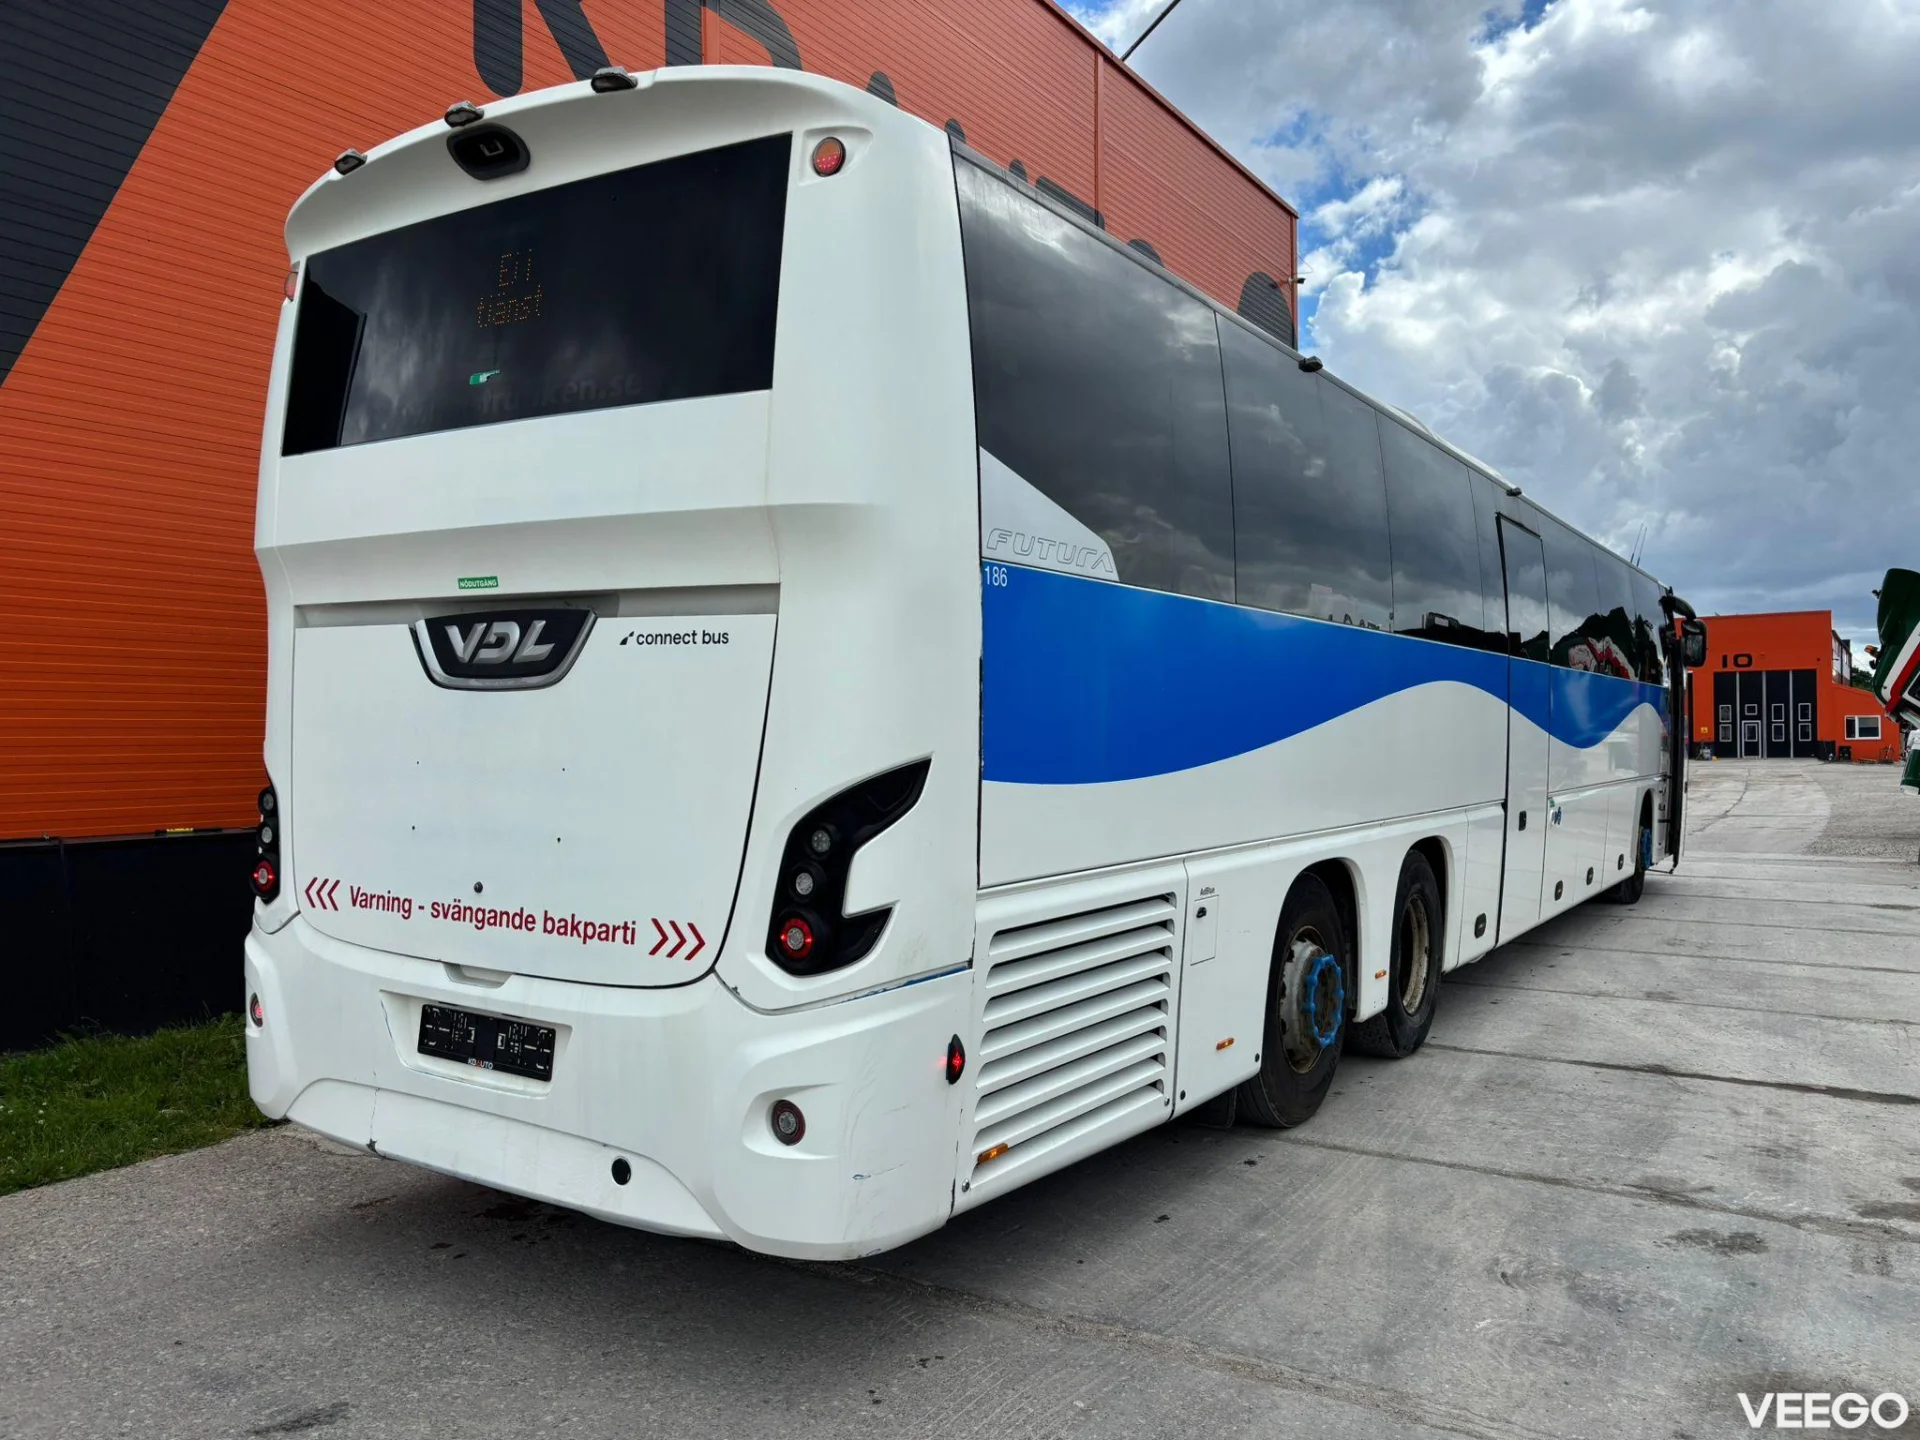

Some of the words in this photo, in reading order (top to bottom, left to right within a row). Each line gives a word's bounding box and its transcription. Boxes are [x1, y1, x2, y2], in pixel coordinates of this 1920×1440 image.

[476, 283, 542, 328] tjänst
[986, 527, 1114, 573] FUTURA
[459, 578, 498, 588] NÖDUTGÅNG
[984, 565, 1008, 587] 186
[444, 619, 556, 664] VDL
[636, 629, 698, 645] connect
[702, 629, 729, 645] bus
[1721, 653, 1753, 668] 10
[349, 885, 413, 920] Varning
[430, 898, 537, 930] svängande
[542, 910, 637, 945] bakparti
